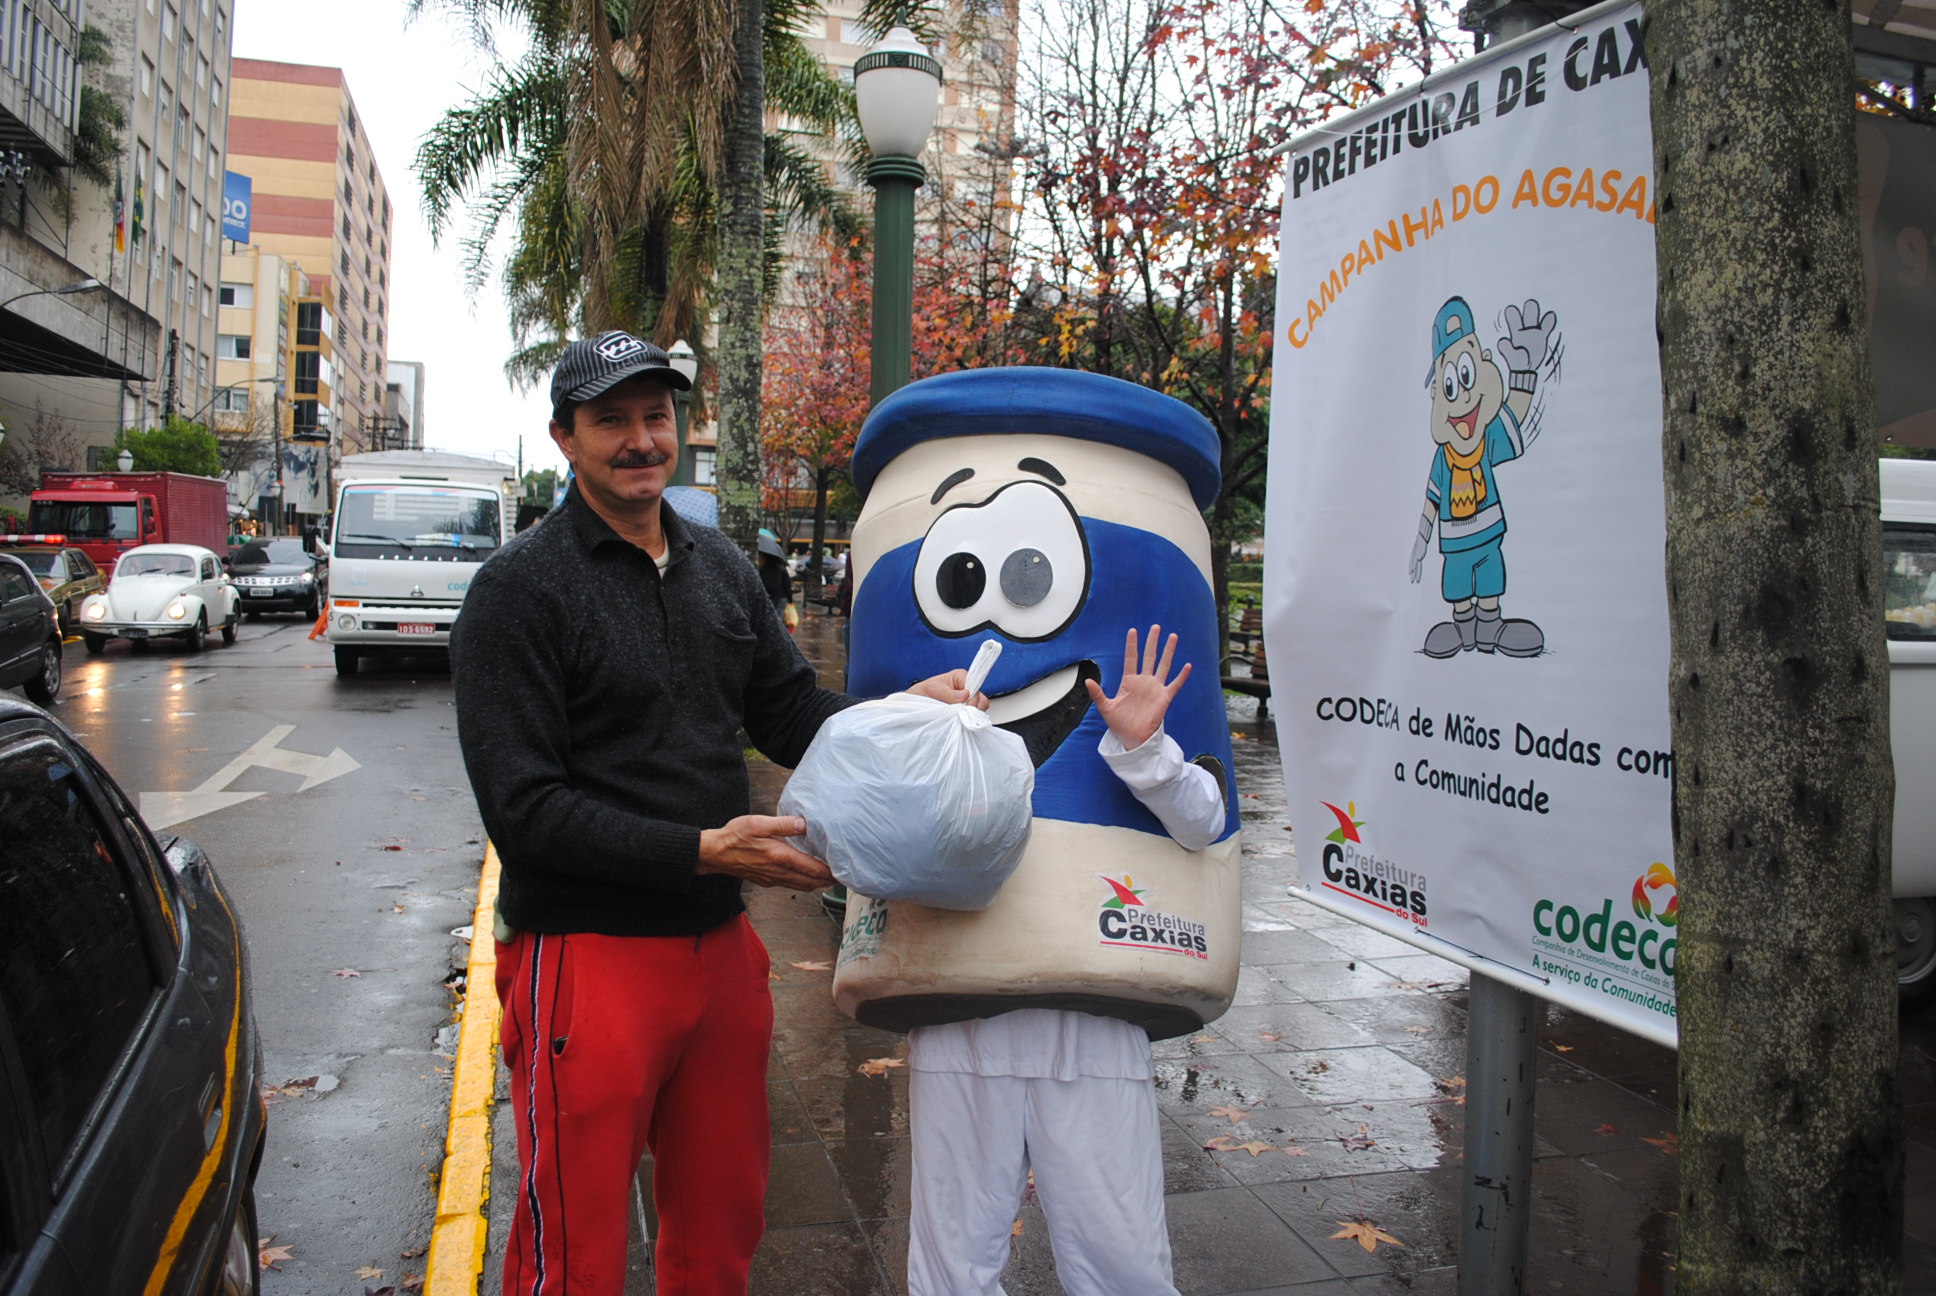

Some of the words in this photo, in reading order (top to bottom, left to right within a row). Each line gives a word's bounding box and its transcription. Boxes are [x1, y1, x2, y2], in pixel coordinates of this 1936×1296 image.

[1292, 80, 1480, 200] PREFEITURA
[1495, 52, 1546, 118] DE
[1287, 198, 1444, 350] CAMPANHA
[1451, 174, 1500, 224] DO
[1316, 696, 1400, 731] CODECA
[1408, 707, 1434, 737] de
[1444, 713, 1500, 751] Mãos
[1515, 722, 1601, 766] Dadas
[1394, 761, 1405, 782] a
[1414, 759, 1550, 815] Comunidade
[1322, 843, 1427, 916] Caxias
[1345, 845, 1427, 892] Prefeitura
[1099, 909, 1207, 953] Caxias
[1128, 908, 1205, 937] Prefeitura
[1396, 908, 1409, 920] do
[1411, 913, 1428, 927] Sul
[1184, 948, 1195, 957] do
[1197, 949, 1209, 960] Sul
[1532, 935, 1566, 954] Companhia
[1577, 949, 1629, 975] Desenvolvimento
[1631, 966, 1639, 978] de
[1532, 954, 1540, 969] A
[1542, 960, 1580, 984] serviço
[1584, 971, 1598, 989] da
[1602, 977, 1677, 1018] Comunidade
